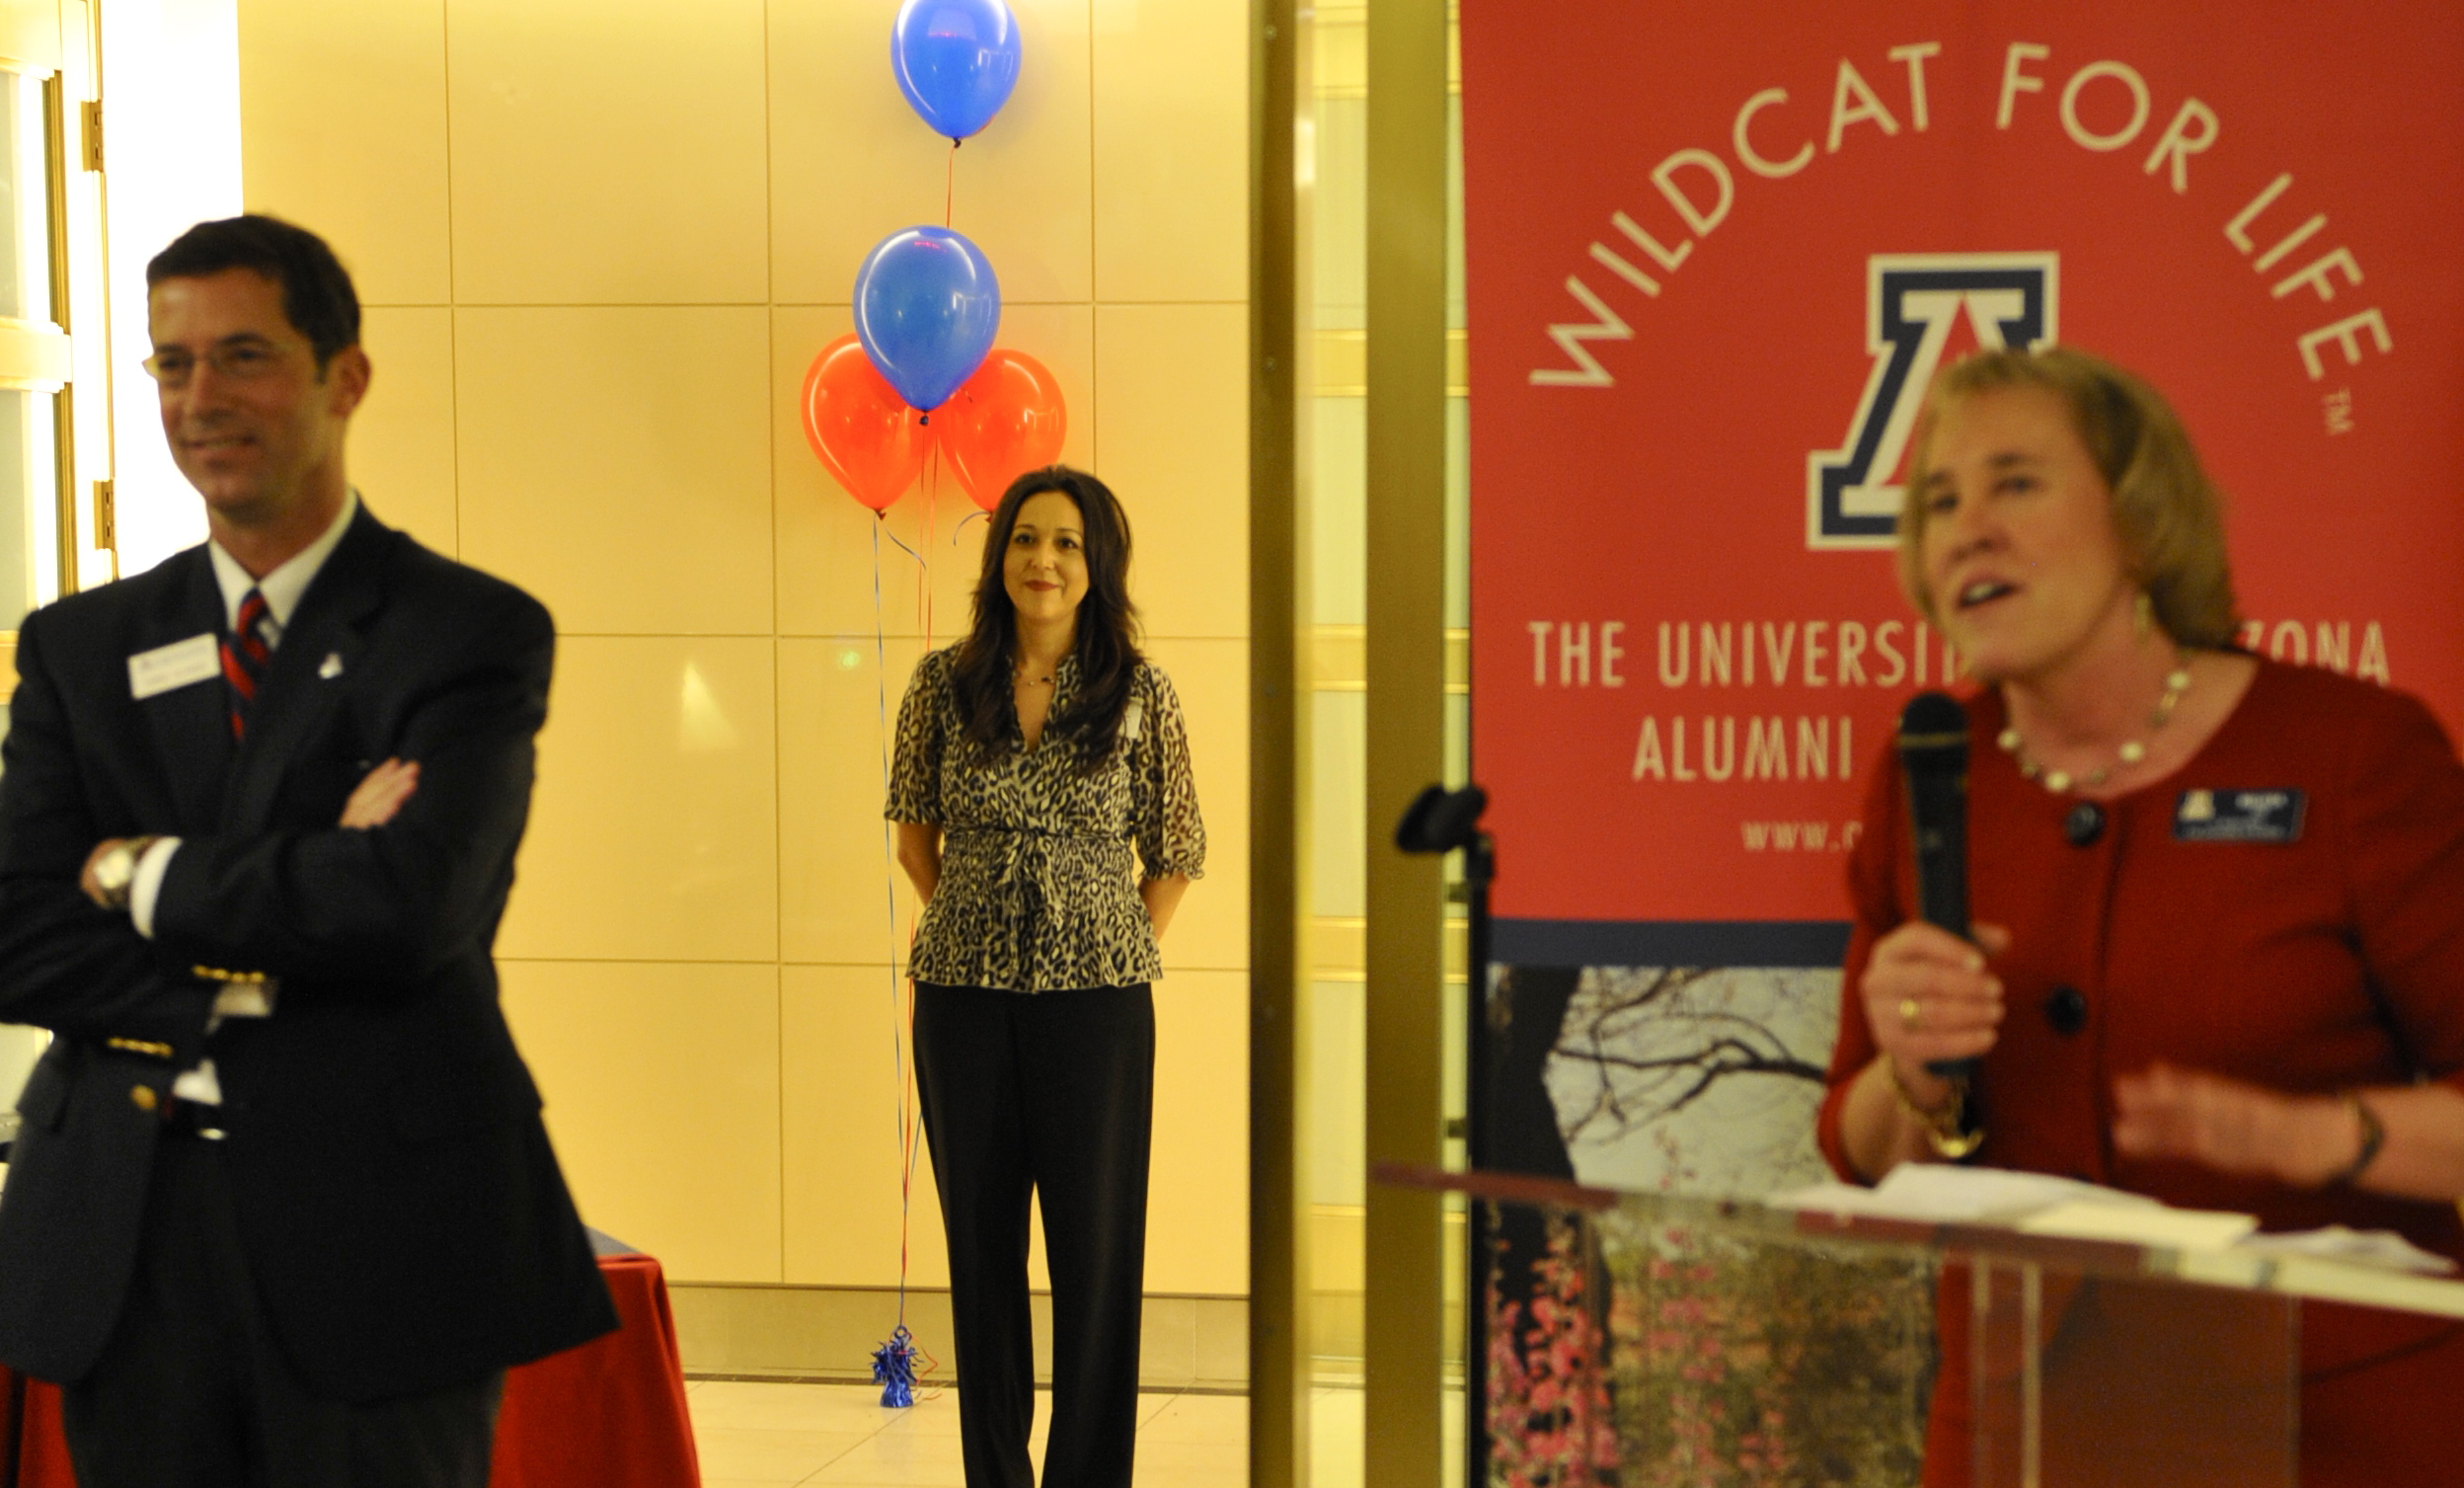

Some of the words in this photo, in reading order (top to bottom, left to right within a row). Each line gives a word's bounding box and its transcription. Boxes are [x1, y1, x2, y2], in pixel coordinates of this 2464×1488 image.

[1528, 40, 1942, 387] WILDCAT
[1995, 41, 2219, 192] FOR
[2224, 172, 2393, 381] LIFE
[1806, 251, 2059, 550] A
[1528, 620, 1625, 687] THE
[1657, 620, 1959, 688] UNIVERSI
[1632, 715, 1852, 781] ALUMNI
